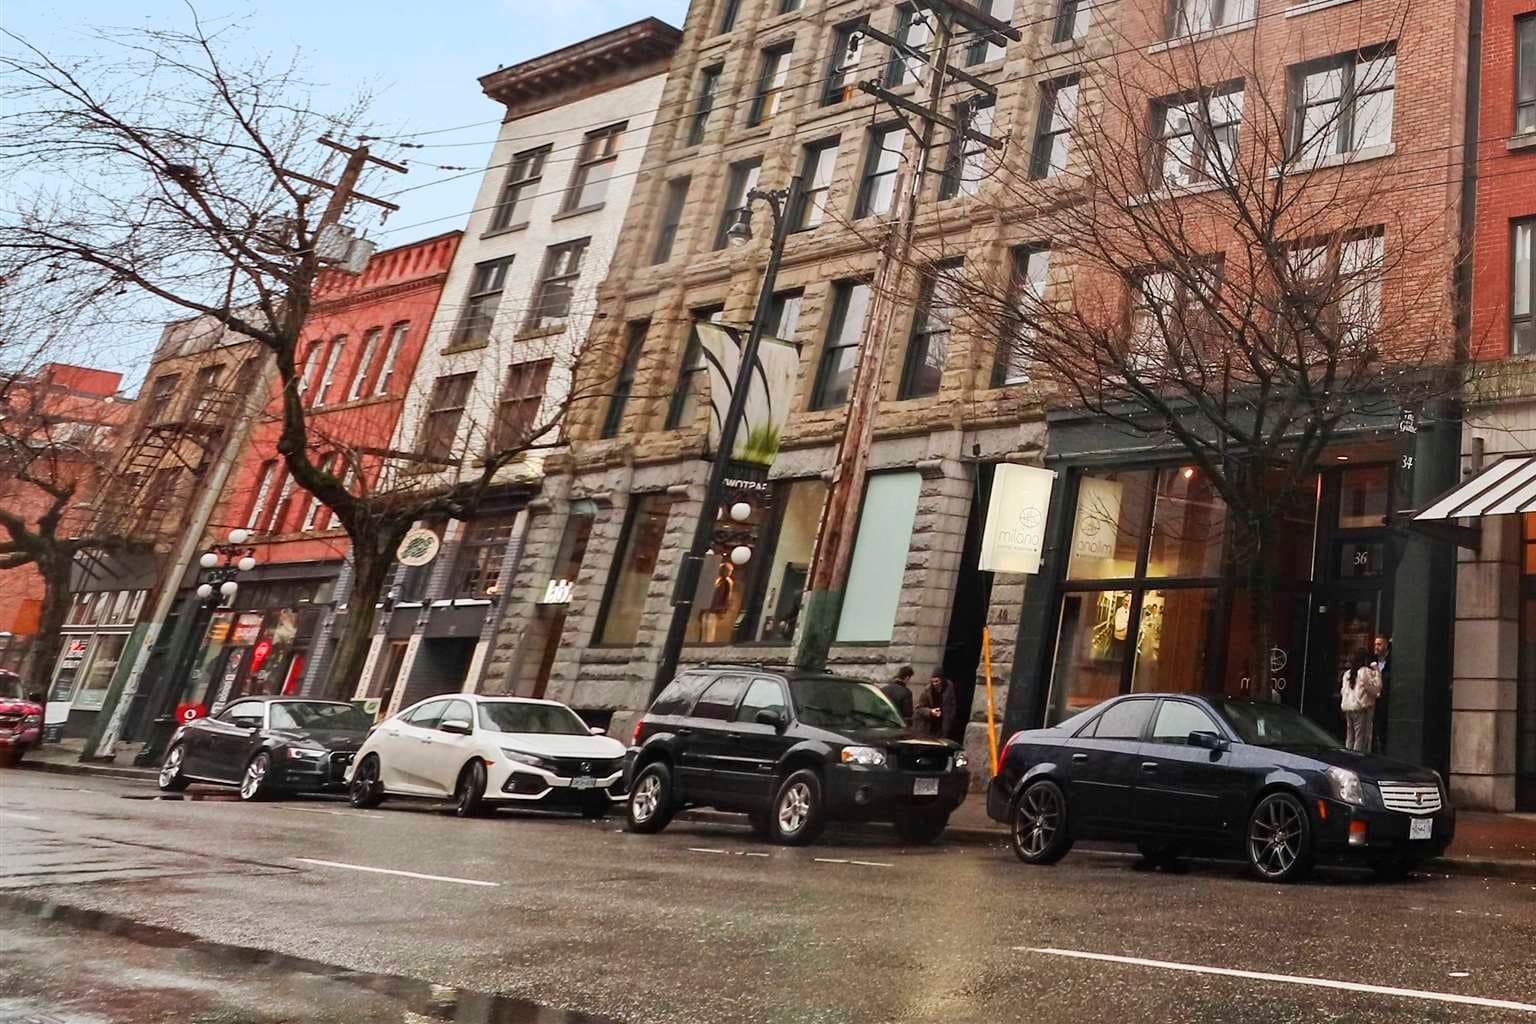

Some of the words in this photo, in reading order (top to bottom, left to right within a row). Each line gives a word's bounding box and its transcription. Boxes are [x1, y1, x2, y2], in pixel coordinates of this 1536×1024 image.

[1402, 455, 1413, 469] 34
[999, 528, 1040, 546] milano
[1354, 551, 1368, 565] 36
